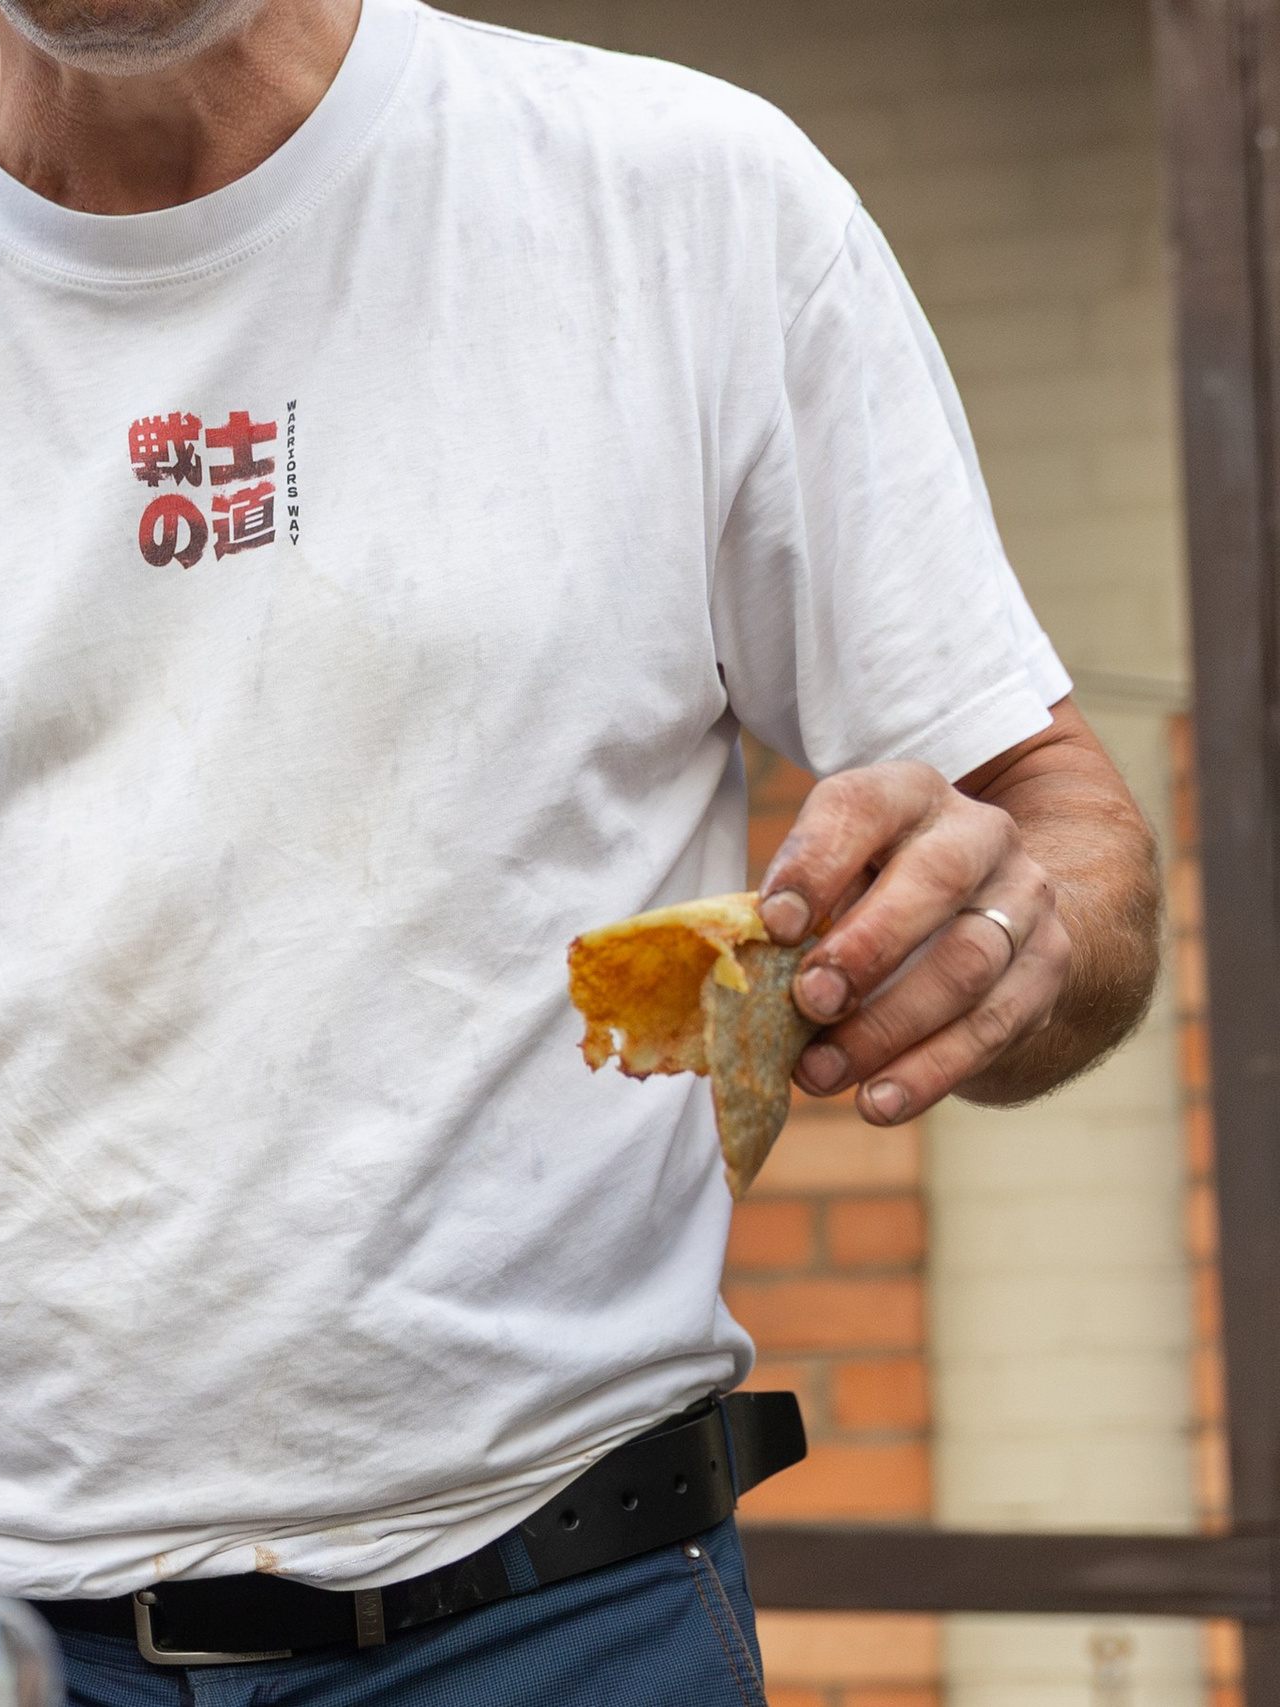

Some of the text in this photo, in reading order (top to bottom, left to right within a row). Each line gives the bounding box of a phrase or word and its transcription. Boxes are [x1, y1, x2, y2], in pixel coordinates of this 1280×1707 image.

[128, 411, 278, 488] 戦士
[286, 399, 300, 546] WARRIORS WAY
[138, 481, 277, 570] の道
